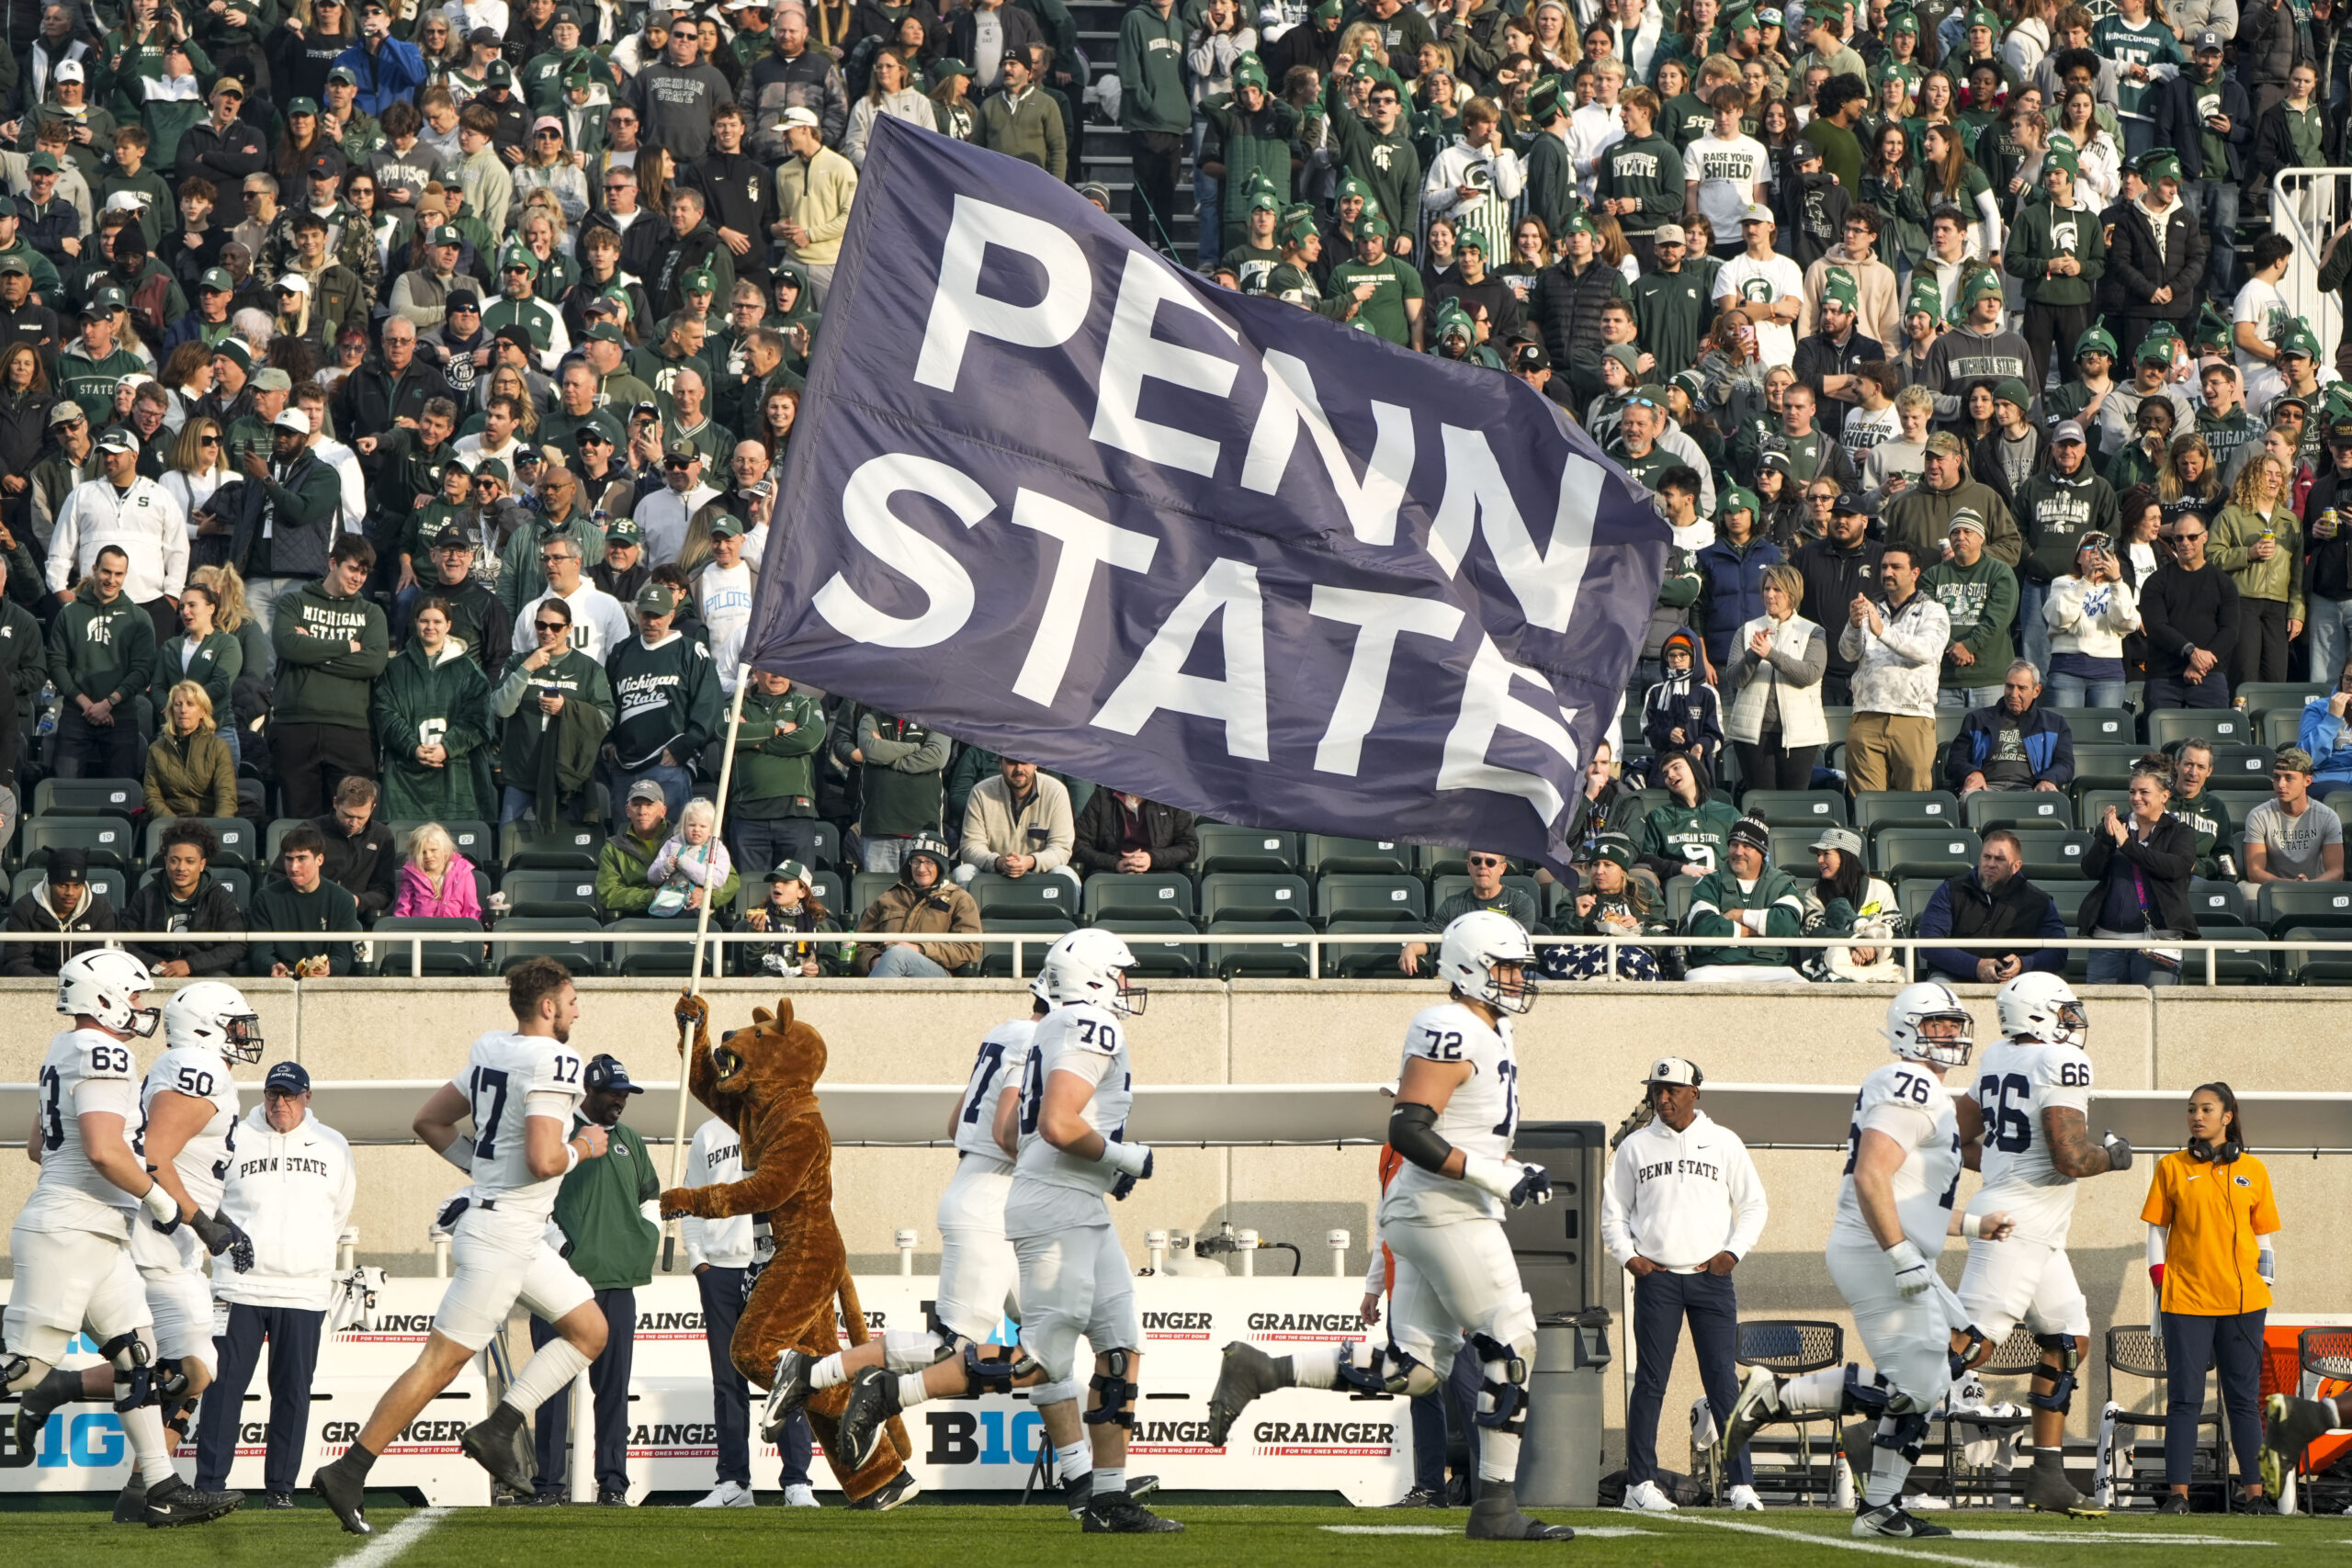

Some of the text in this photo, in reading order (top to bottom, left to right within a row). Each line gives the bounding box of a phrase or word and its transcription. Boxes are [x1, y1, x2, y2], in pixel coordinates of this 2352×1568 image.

[2105, 32, 2160, 47] HOMECOMING
[650, 77, 706, 96] MICHIGAN
[657, 89, 694, 104] STATE
[1612, 154, 1658, 178] STATE
[1702, 152, 1754, 164] RAISE YOUR
[1703, 163, 1752, 181] SHIELD
[1347, 274, 1396, 283] MICHIGAN STATE
[1958, 358, 2018, 376] MICHIGAN STATE
[80, 384, 113, 395] STATE
[913, 194, 1606, 634] PENN
[1869, 422, 1893, 435] YOUR
[138, 496, 150, 508] S
[2036, 502, 2091, 522] CHAMPIONS
[1935, 582, 1987, 600] MICHIGAN STATE
[705, 591, 752, 616] PILOTS
[303, 605, 367, 627] MICHIGAN
[309, 624, 357, 642] STATE
[811, 453, 1578, 829] STATE
[556, 679, 579, 691] STATE
[616, 674, 679, 703] Michigan
[621, 694, 665, 710] State
[2194, 814, 2219, 839] STATE
[2272, 828, 2318, 840] MICHIGAN
[1667, 832, 1721, 844] MICHIGAN STATE
[2280, 840, 2310, 852] STATE
[1680, 843, 1717, 874] 9
[1077, 1019, 1116, 1053] 70
[1425, 1029, 1463, 1060] 72
[91, 1045, 129, 1073] 63
[553, 1055, 579, 1085] 17
[177, 1066, 214, 1098] 50
[2060, 1062, 2090, 1087] 66
[1893, 1070, 1931, 1105] 76
[239, 1156, 328, 1179] PENN STATE
[707, 1145, 741, 1169] PENN
[1638, 1159, 1719, 1183] PENN STATE
[635, 1312, 707, 1330] AINGE
[1141, 1312, 1213, 1330] INGER
[1247, 1313, 1367, 1332] GRAINGER
[322, 1421, 467, 1444] GRNGER
[627, 1423, 718, 1446] AINGE
[1130, 1421, 1212, 1443] AINGE
[1252, 1421, 1395, 1444] GRAINGER
